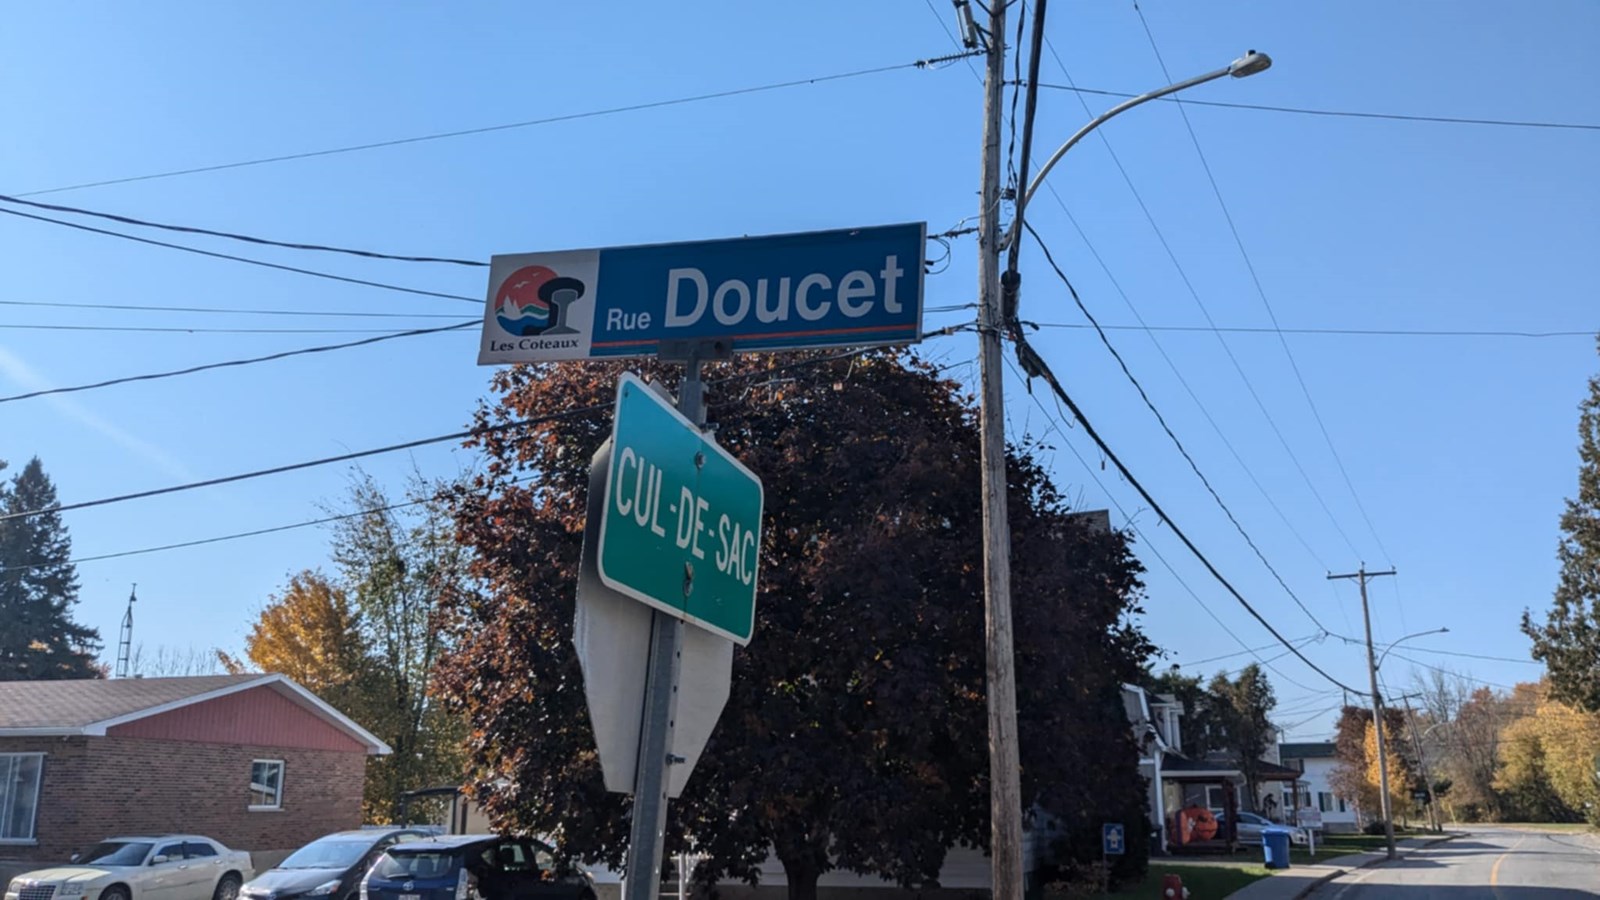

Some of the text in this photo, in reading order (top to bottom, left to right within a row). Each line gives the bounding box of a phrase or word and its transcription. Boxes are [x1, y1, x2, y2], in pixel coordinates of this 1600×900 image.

[605, 254, 905, 331] Rue Doucet
[490, 338, 580, 351] Les Coteaux
[615, 447, 755, 585] CUL-DE-SAC
